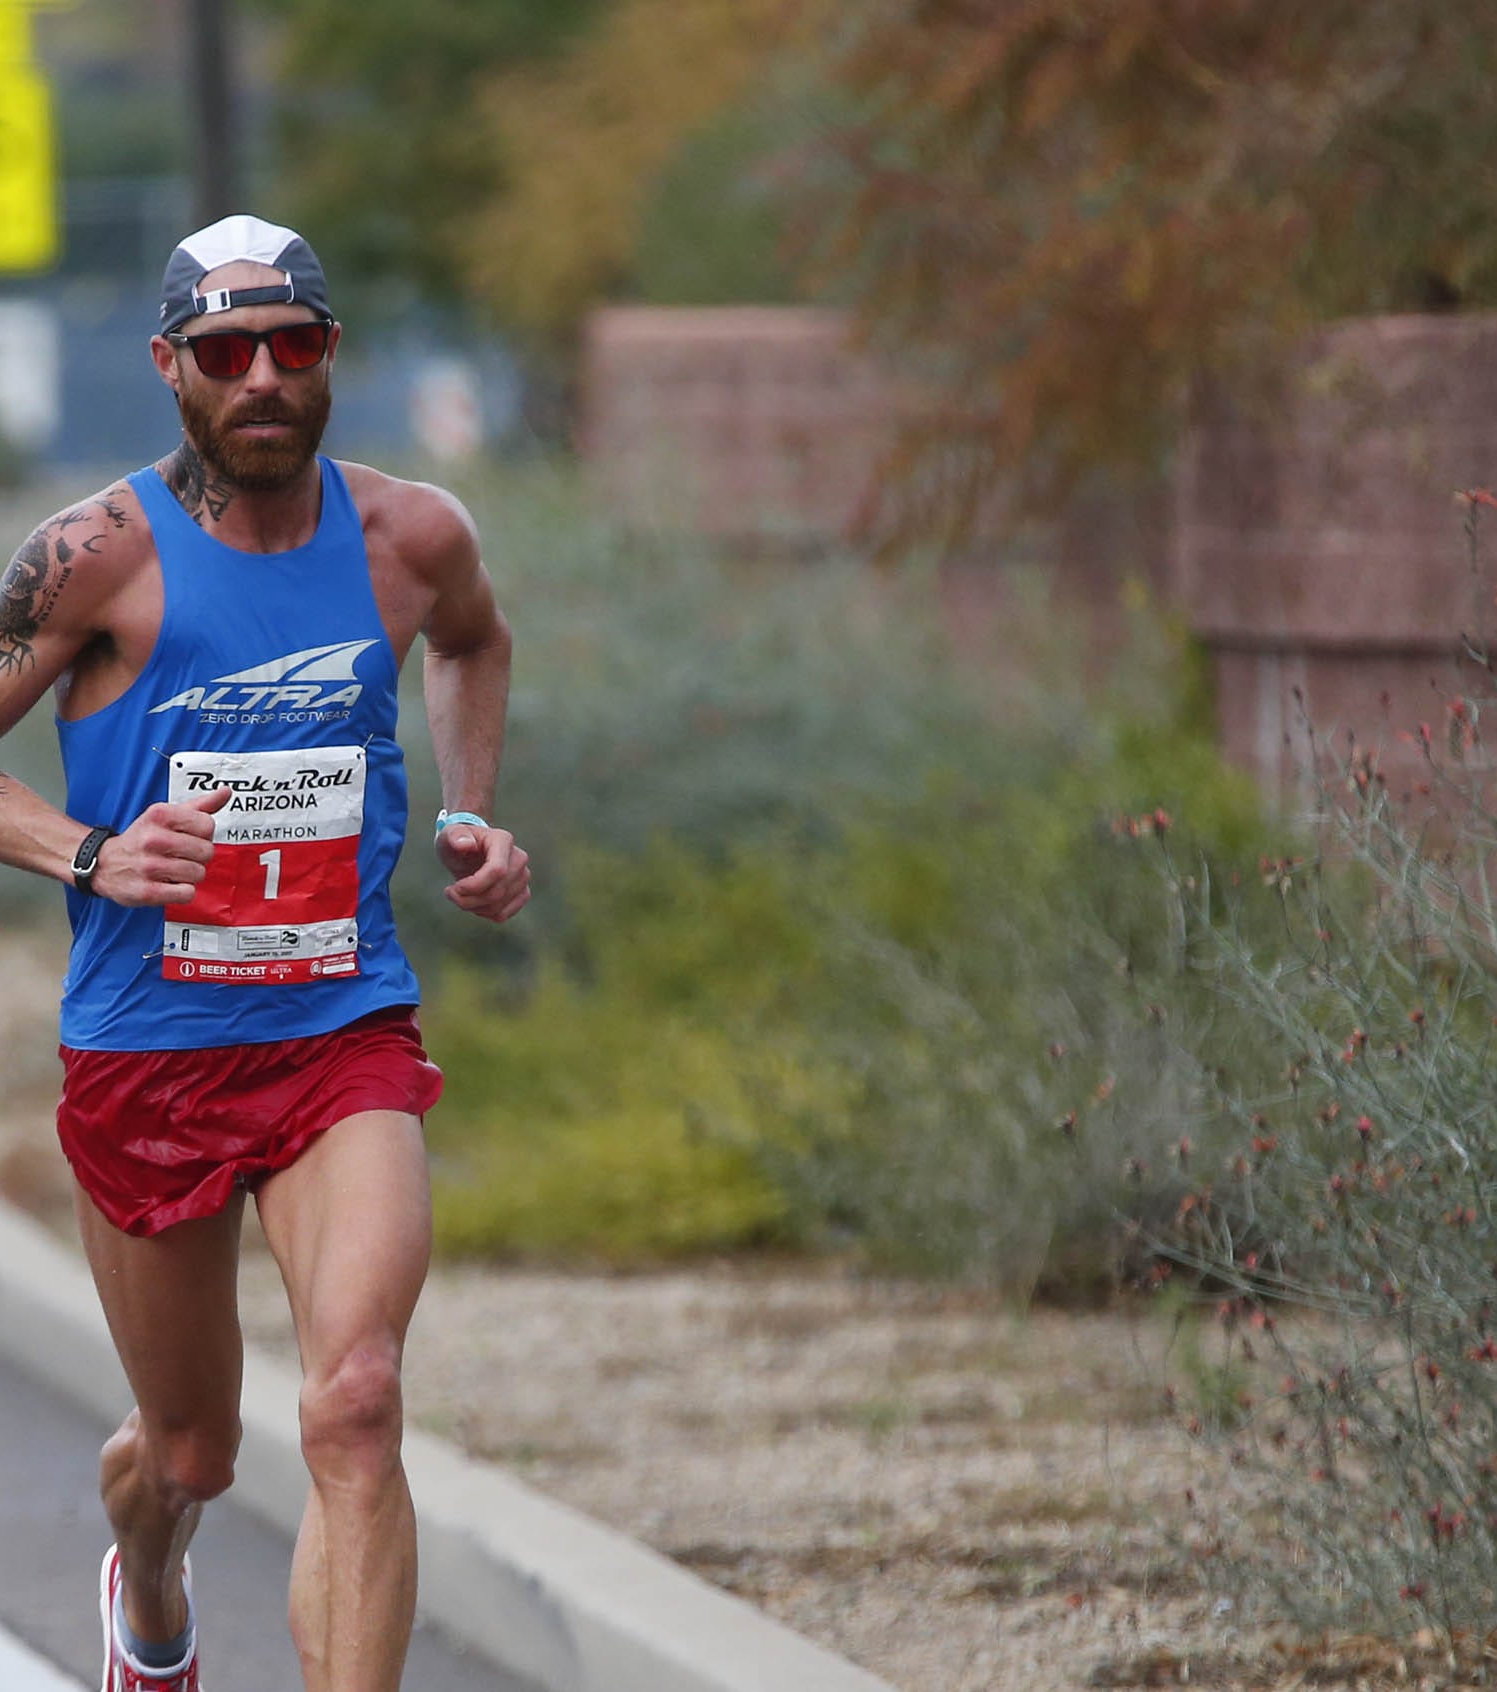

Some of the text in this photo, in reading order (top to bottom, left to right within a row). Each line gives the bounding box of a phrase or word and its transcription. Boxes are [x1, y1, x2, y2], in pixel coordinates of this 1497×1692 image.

[147, 684, 363, 714] ALTRA
[199, 710, 351, 724] ZERO DROP FOOTWEAR
[296, 767, 354, 789] Roll
[229, 793, 319, 812] ARIZONA
[227, 826, 318, 841] MARATHON
[259, 849, 281, 900] 1
[199, 964, 228, 976] BEER
[230, 966, 267, 976] TICKET
